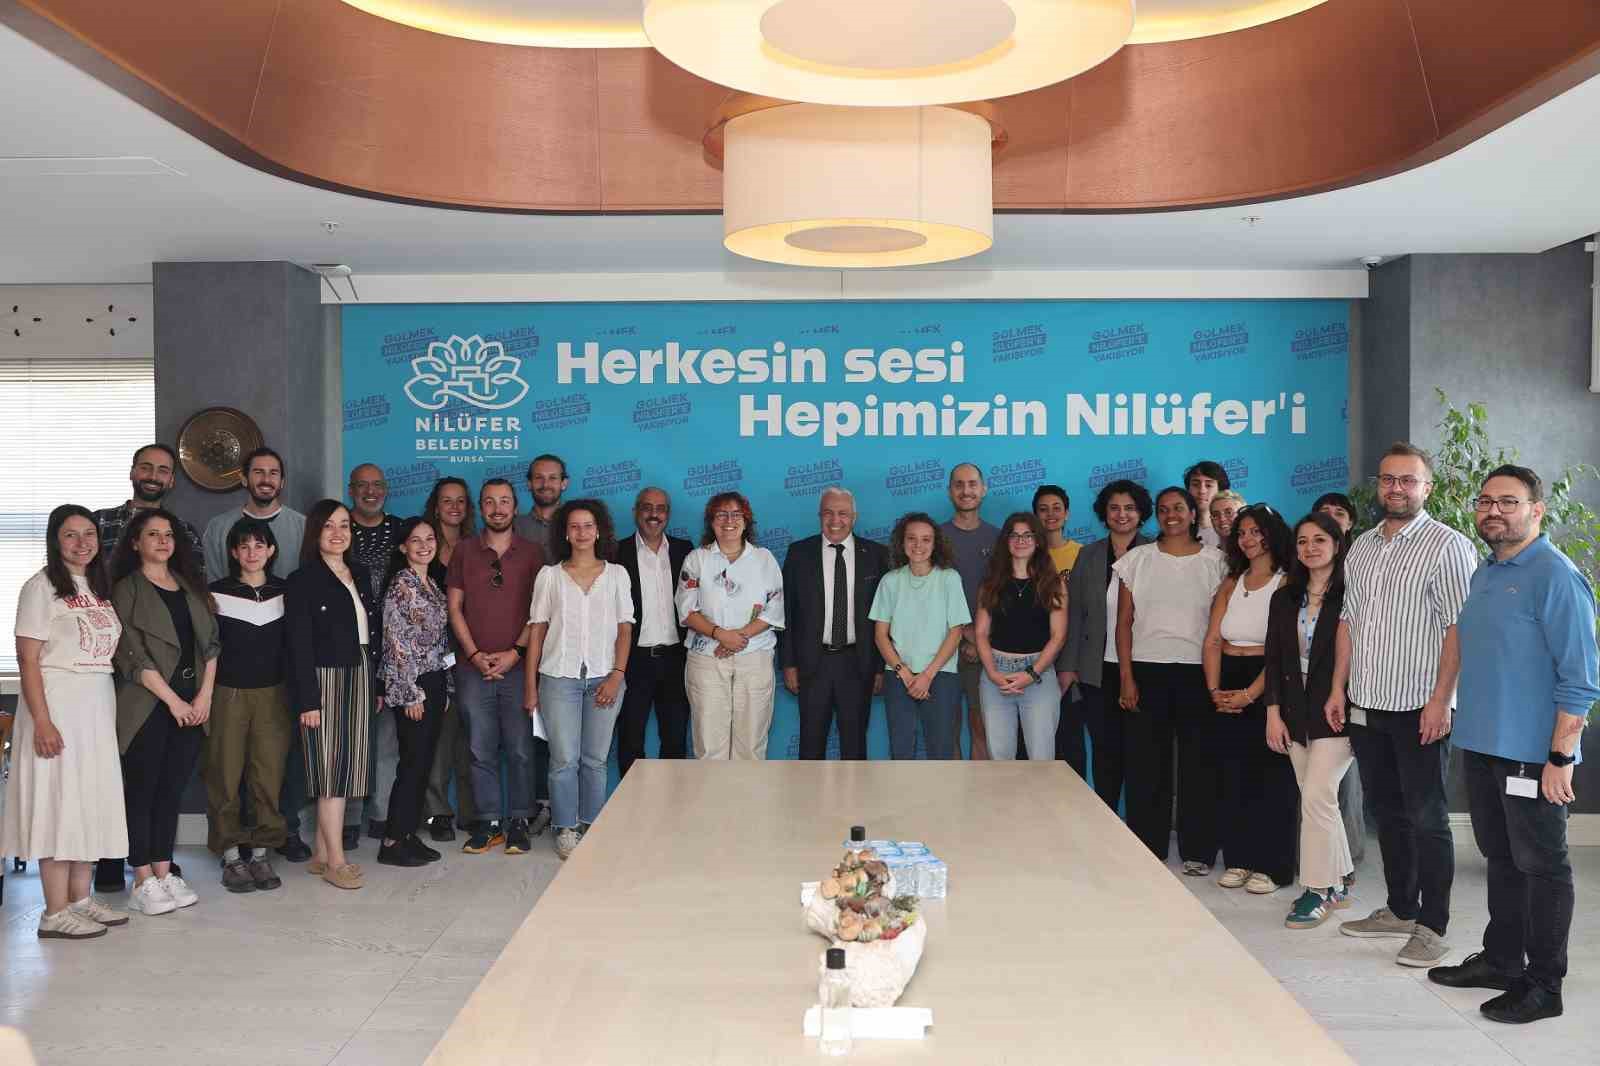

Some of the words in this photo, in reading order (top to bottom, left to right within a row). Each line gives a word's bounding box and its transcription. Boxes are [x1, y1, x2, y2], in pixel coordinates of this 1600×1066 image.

[557, 340, 826, 385] Herkesin
[845, 340, 964, 385] sesi
[415, 413, 522, 433] NİLÜFER
[739, 393, 1047, 447] Hepimizin
[1066, 392, 1306, 437] Nilüfer'i
[415, 435, 519, 451] BELEDİYESİ
[450, 455, 485, 463] BURSA
